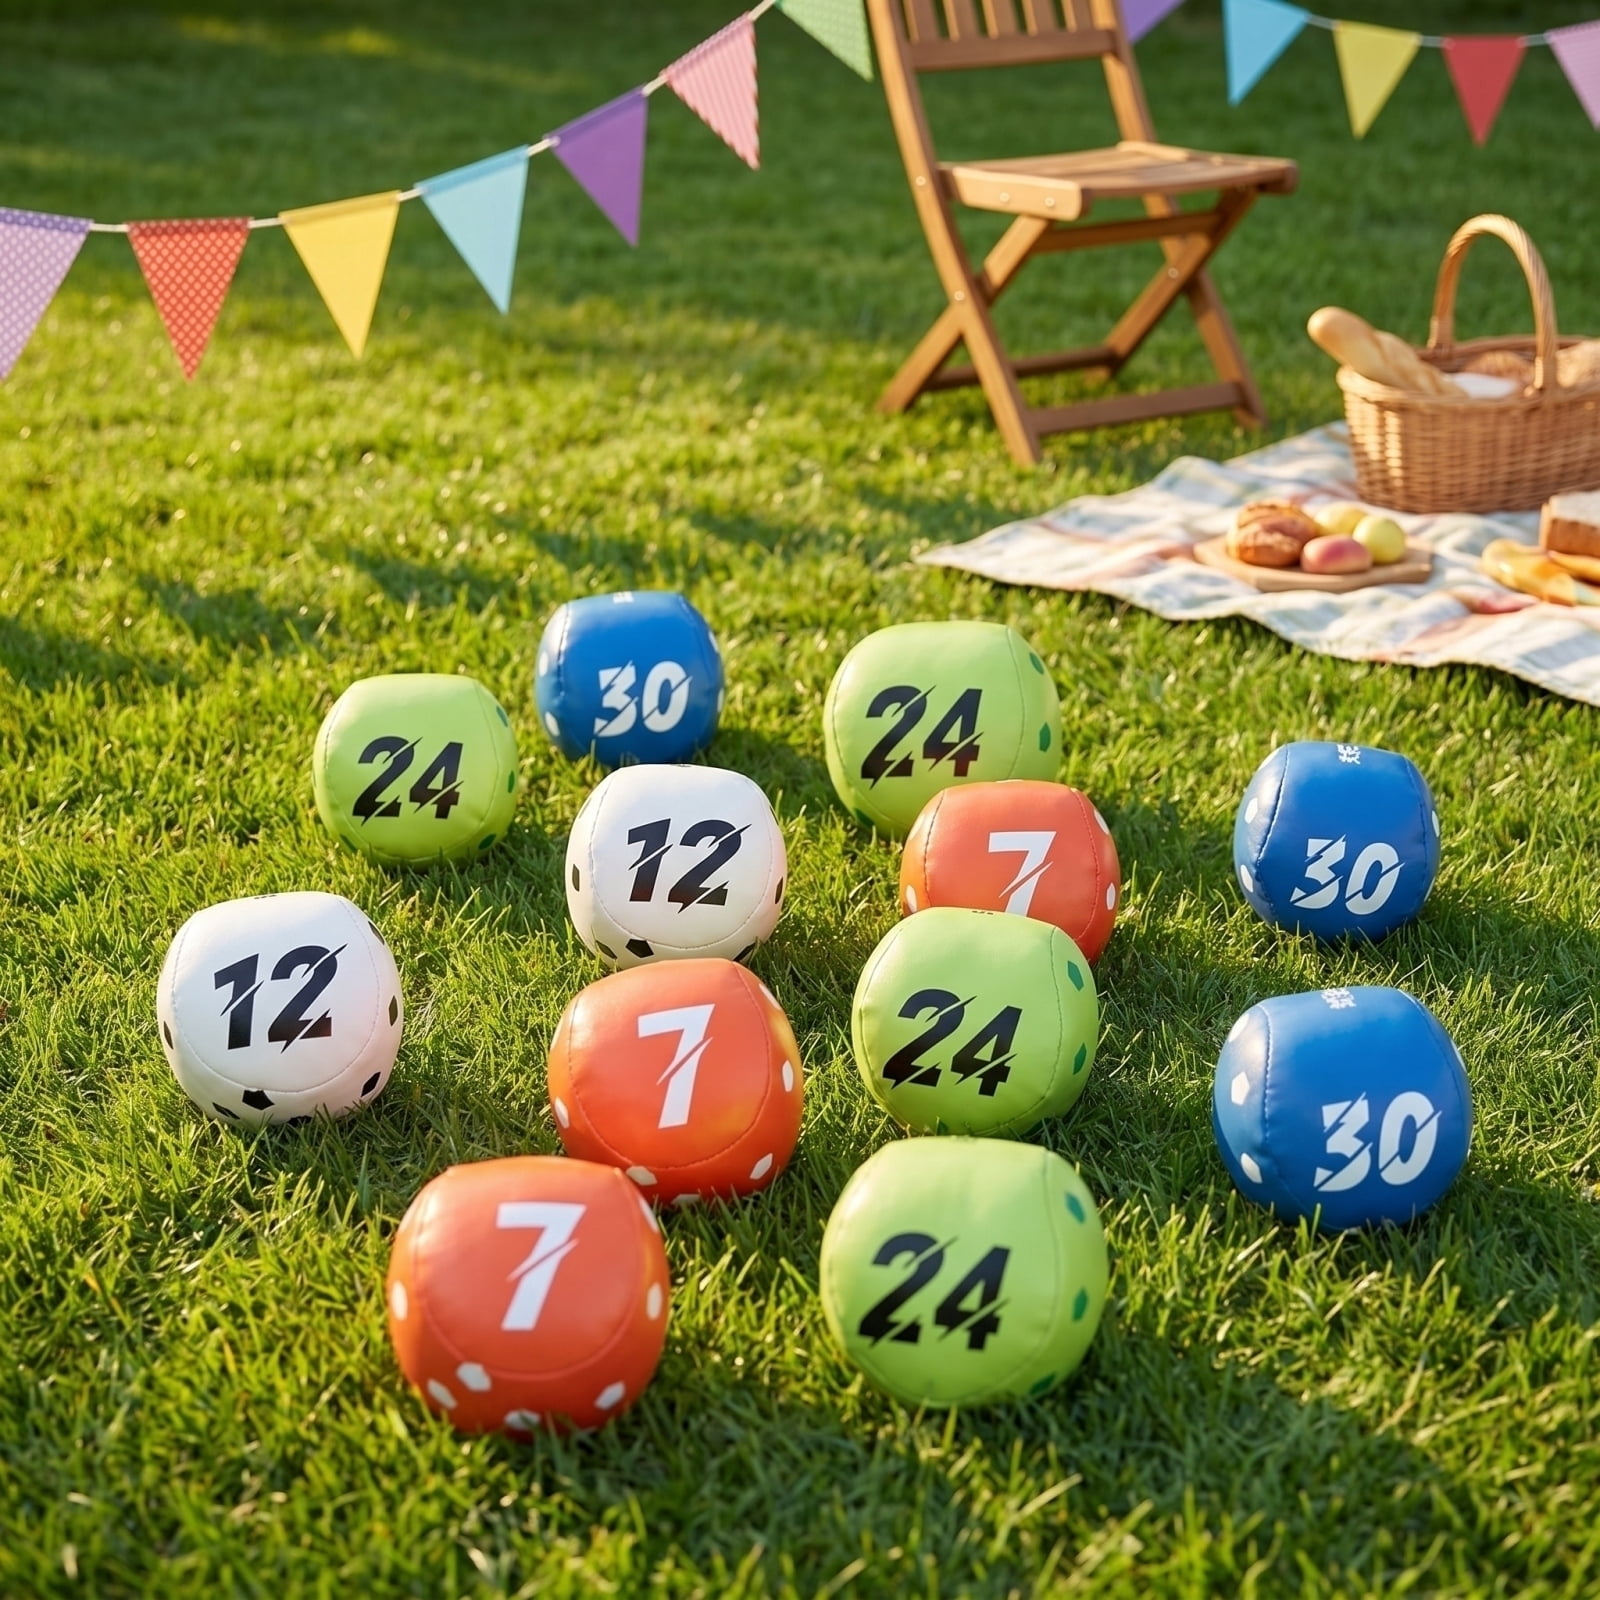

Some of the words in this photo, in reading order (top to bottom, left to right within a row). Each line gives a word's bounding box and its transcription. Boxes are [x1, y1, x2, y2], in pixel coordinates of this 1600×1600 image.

[593, 660, 693, 737] 30
[861, 684, 983, 789] 24
[351, 736, 463, 826] 24
[625, 817, 752, 914] 12
[987, 830, 1057, 917] 7
[1290, 834, 1406, 915] 30
[213, 943, 348, 1054] 12
[881, 988, 1024, 1097] 24
[636, 1003, 716, 1129] 7
[1313, 1090, 1442, 1194] 30
[495, 1202, 587, 1332] 7
[857, 1230, 1012, 1351] 24
